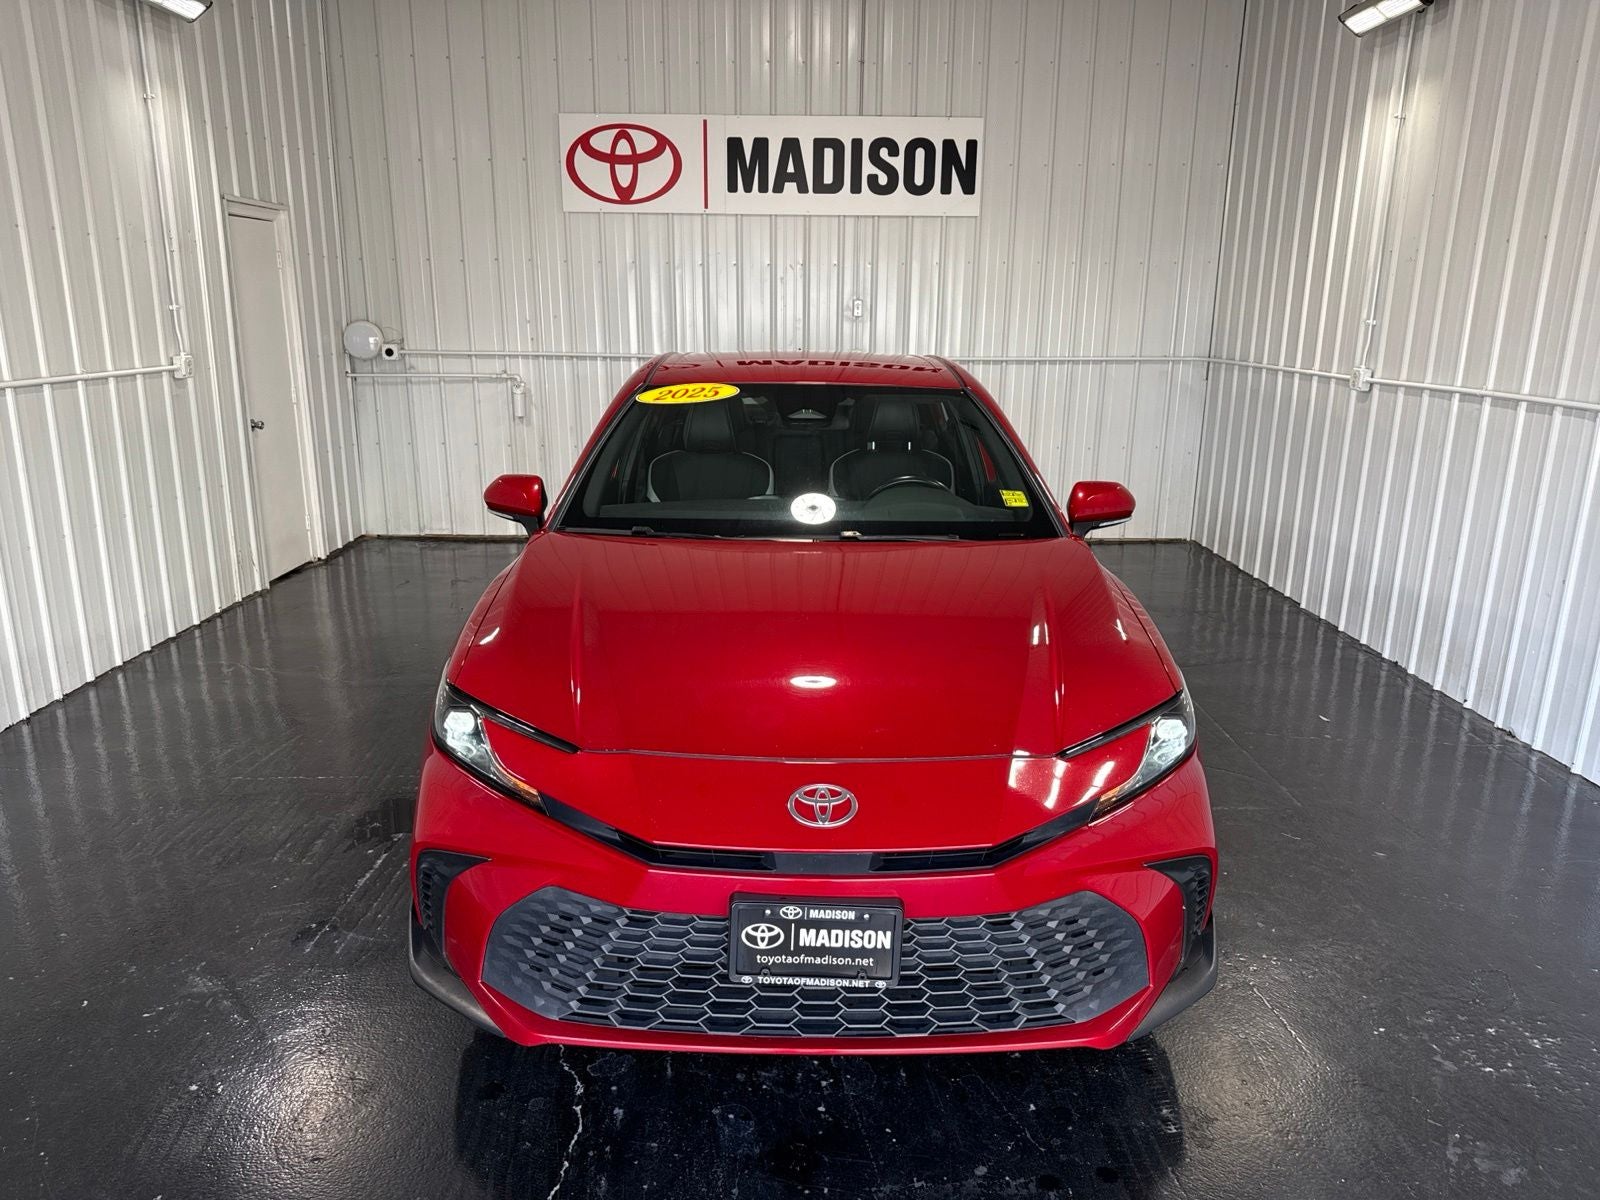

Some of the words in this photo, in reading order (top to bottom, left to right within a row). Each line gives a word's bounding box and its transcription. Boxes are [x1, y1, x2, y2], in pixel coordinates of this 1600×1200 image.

[726, 136, 978, 195] MADISON
[653, 386, 723, 401] 2025
[809, 909, 856, 920] MADISON
[798, 928, 891, 949] MADISON
[756, 954, 874, 967] toyotaofmadison.net
[757, 976, 870, 988] TOYOTAOFMADISON.NET
